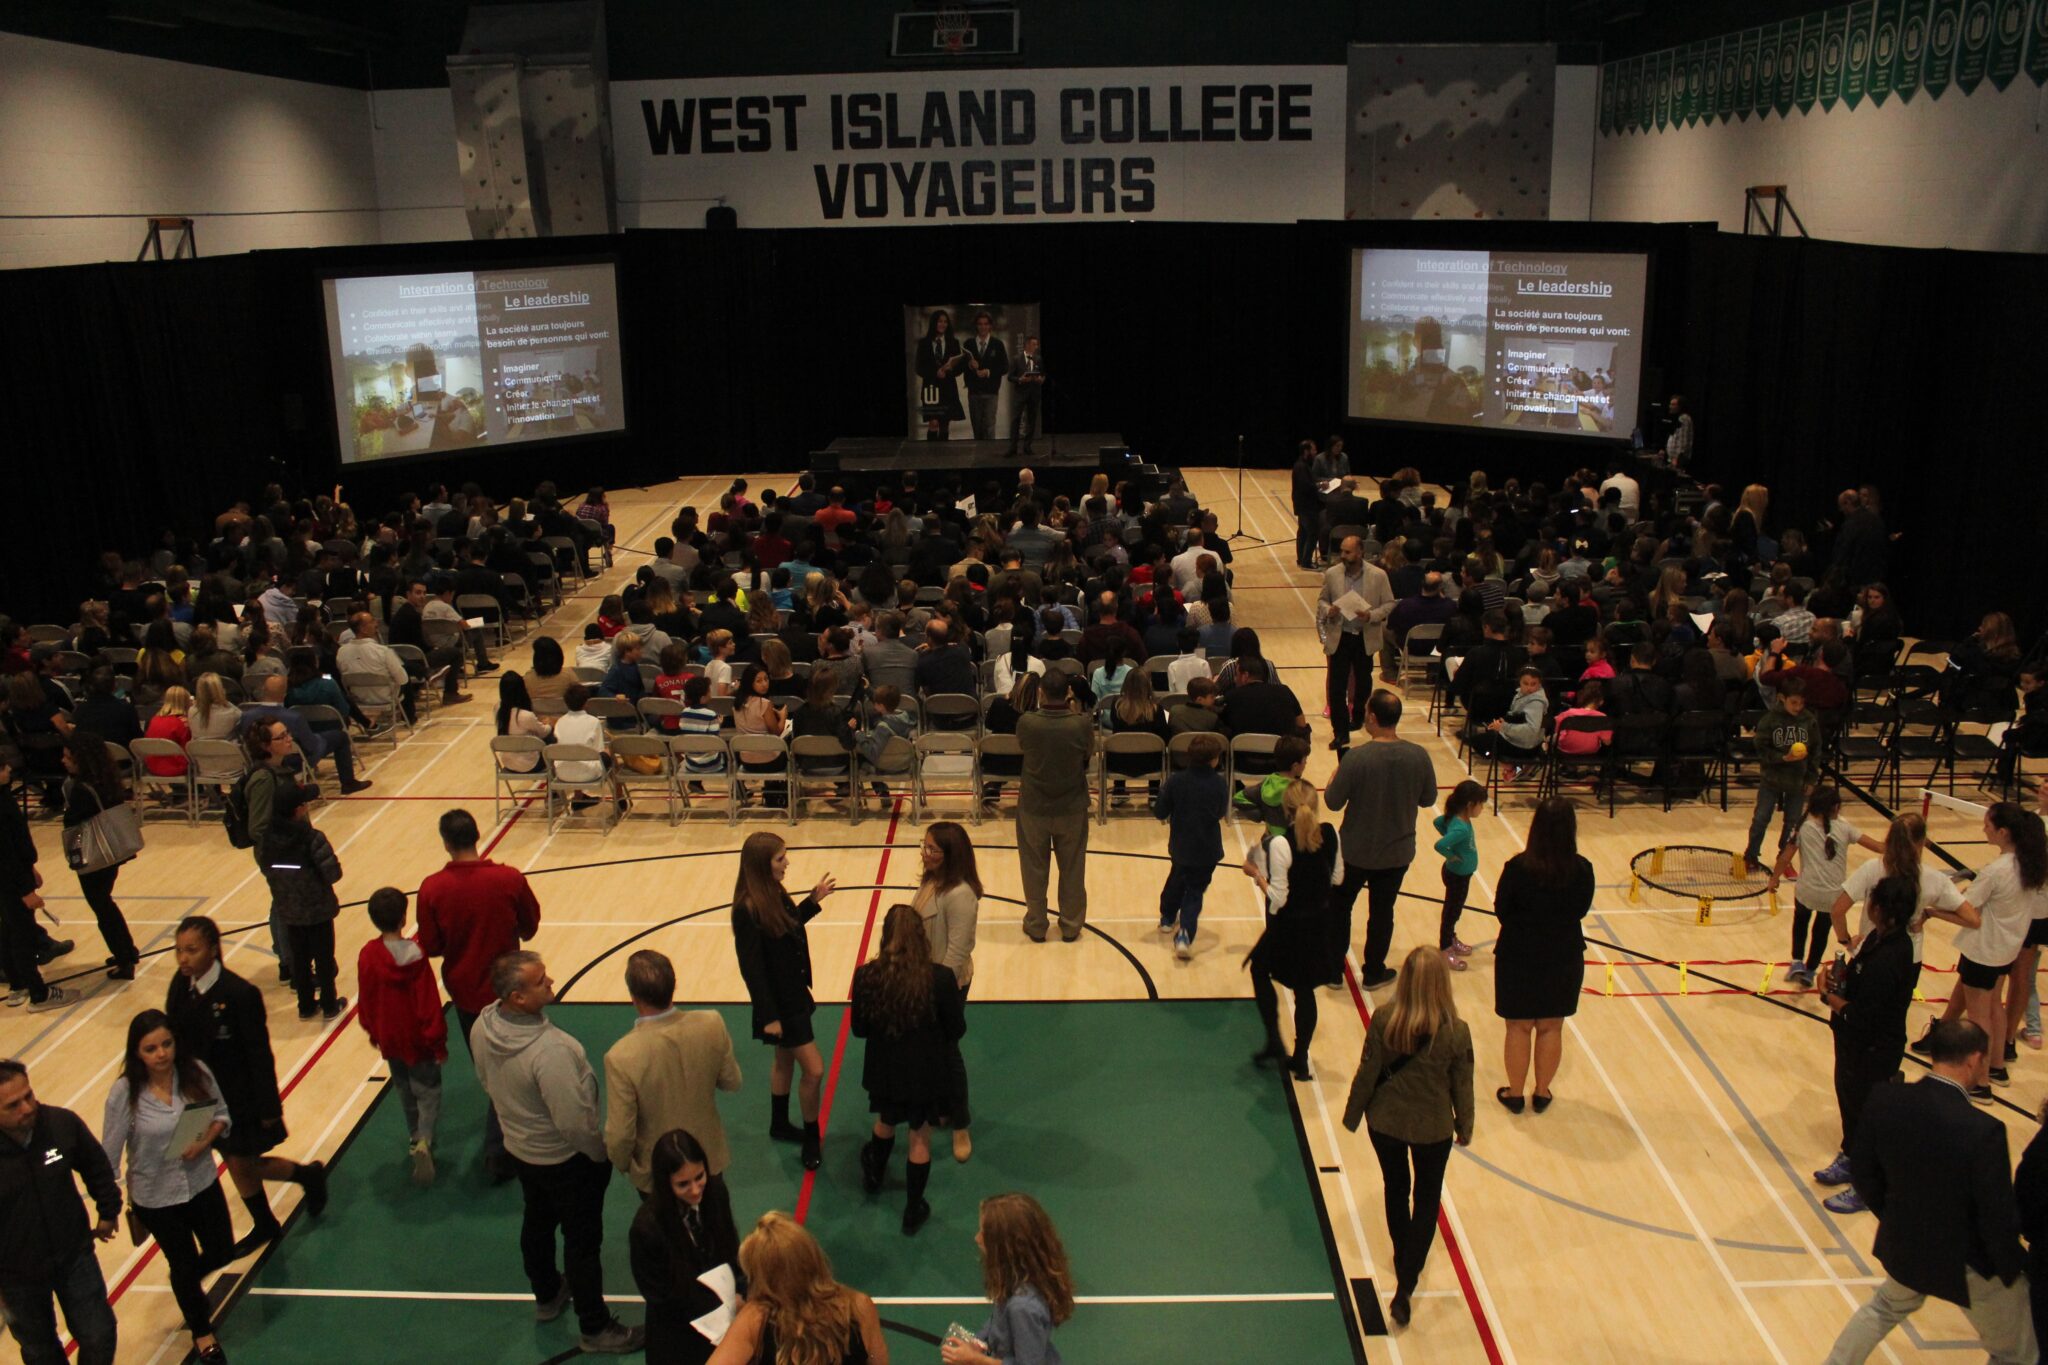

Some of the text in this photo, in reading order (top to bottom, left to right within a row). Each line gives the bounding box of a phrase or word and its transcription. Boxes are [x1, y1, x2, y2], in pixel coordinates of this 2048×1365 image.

[641, 84, 1313, 155] WEST ISLAND COLLEGE
[814, 157, 1155, 219] VOYAGEURS
[1416, 259, 1479, 272] Integration
[1497, 260, 1568, 275] Technology
[399, 281, 464, 298] Integration
[482, 277, 549, 291] Technology
[1517, 279, 1613, 295] Le leadership
[504, 290, 590, 309] Le leadership
[1495, 308, 1603, 323] La société aura toujours
[485, 320, 585, 336] La société aura toujours
[1494, 321, 1524, 332] besoin
[1526, 323, 1537, 333] de
[1539, 325, 1587, 336] personnes
[1589, 326, 1605, 337] qui
[1606, 328, 1631, 337] vont:
[487, 338, 516, 349] besoin
[517, 336, 528, 346] de
[529, 334, 573, 347] personnes
[574, 333, 588, 343] qui
[1507, 349, 1546, 361] Imaginer
[503, 362, 540, 375] Imaginer
[1507, 362, 1570, 376] Communiquer
[504, 374, 562, 387] Communiquer
[506, 402, 531, 412] Initier
[539, 395, 590, 410] changement
[591, 394, 600, 404] et
[1506, 388, 1610, 405] Initier le changement et
[1505, 402, 1557, 415] l'innovation
[507, 411, 556, 425] l'innovation
[1773, 727, 1809, 747] GAP
